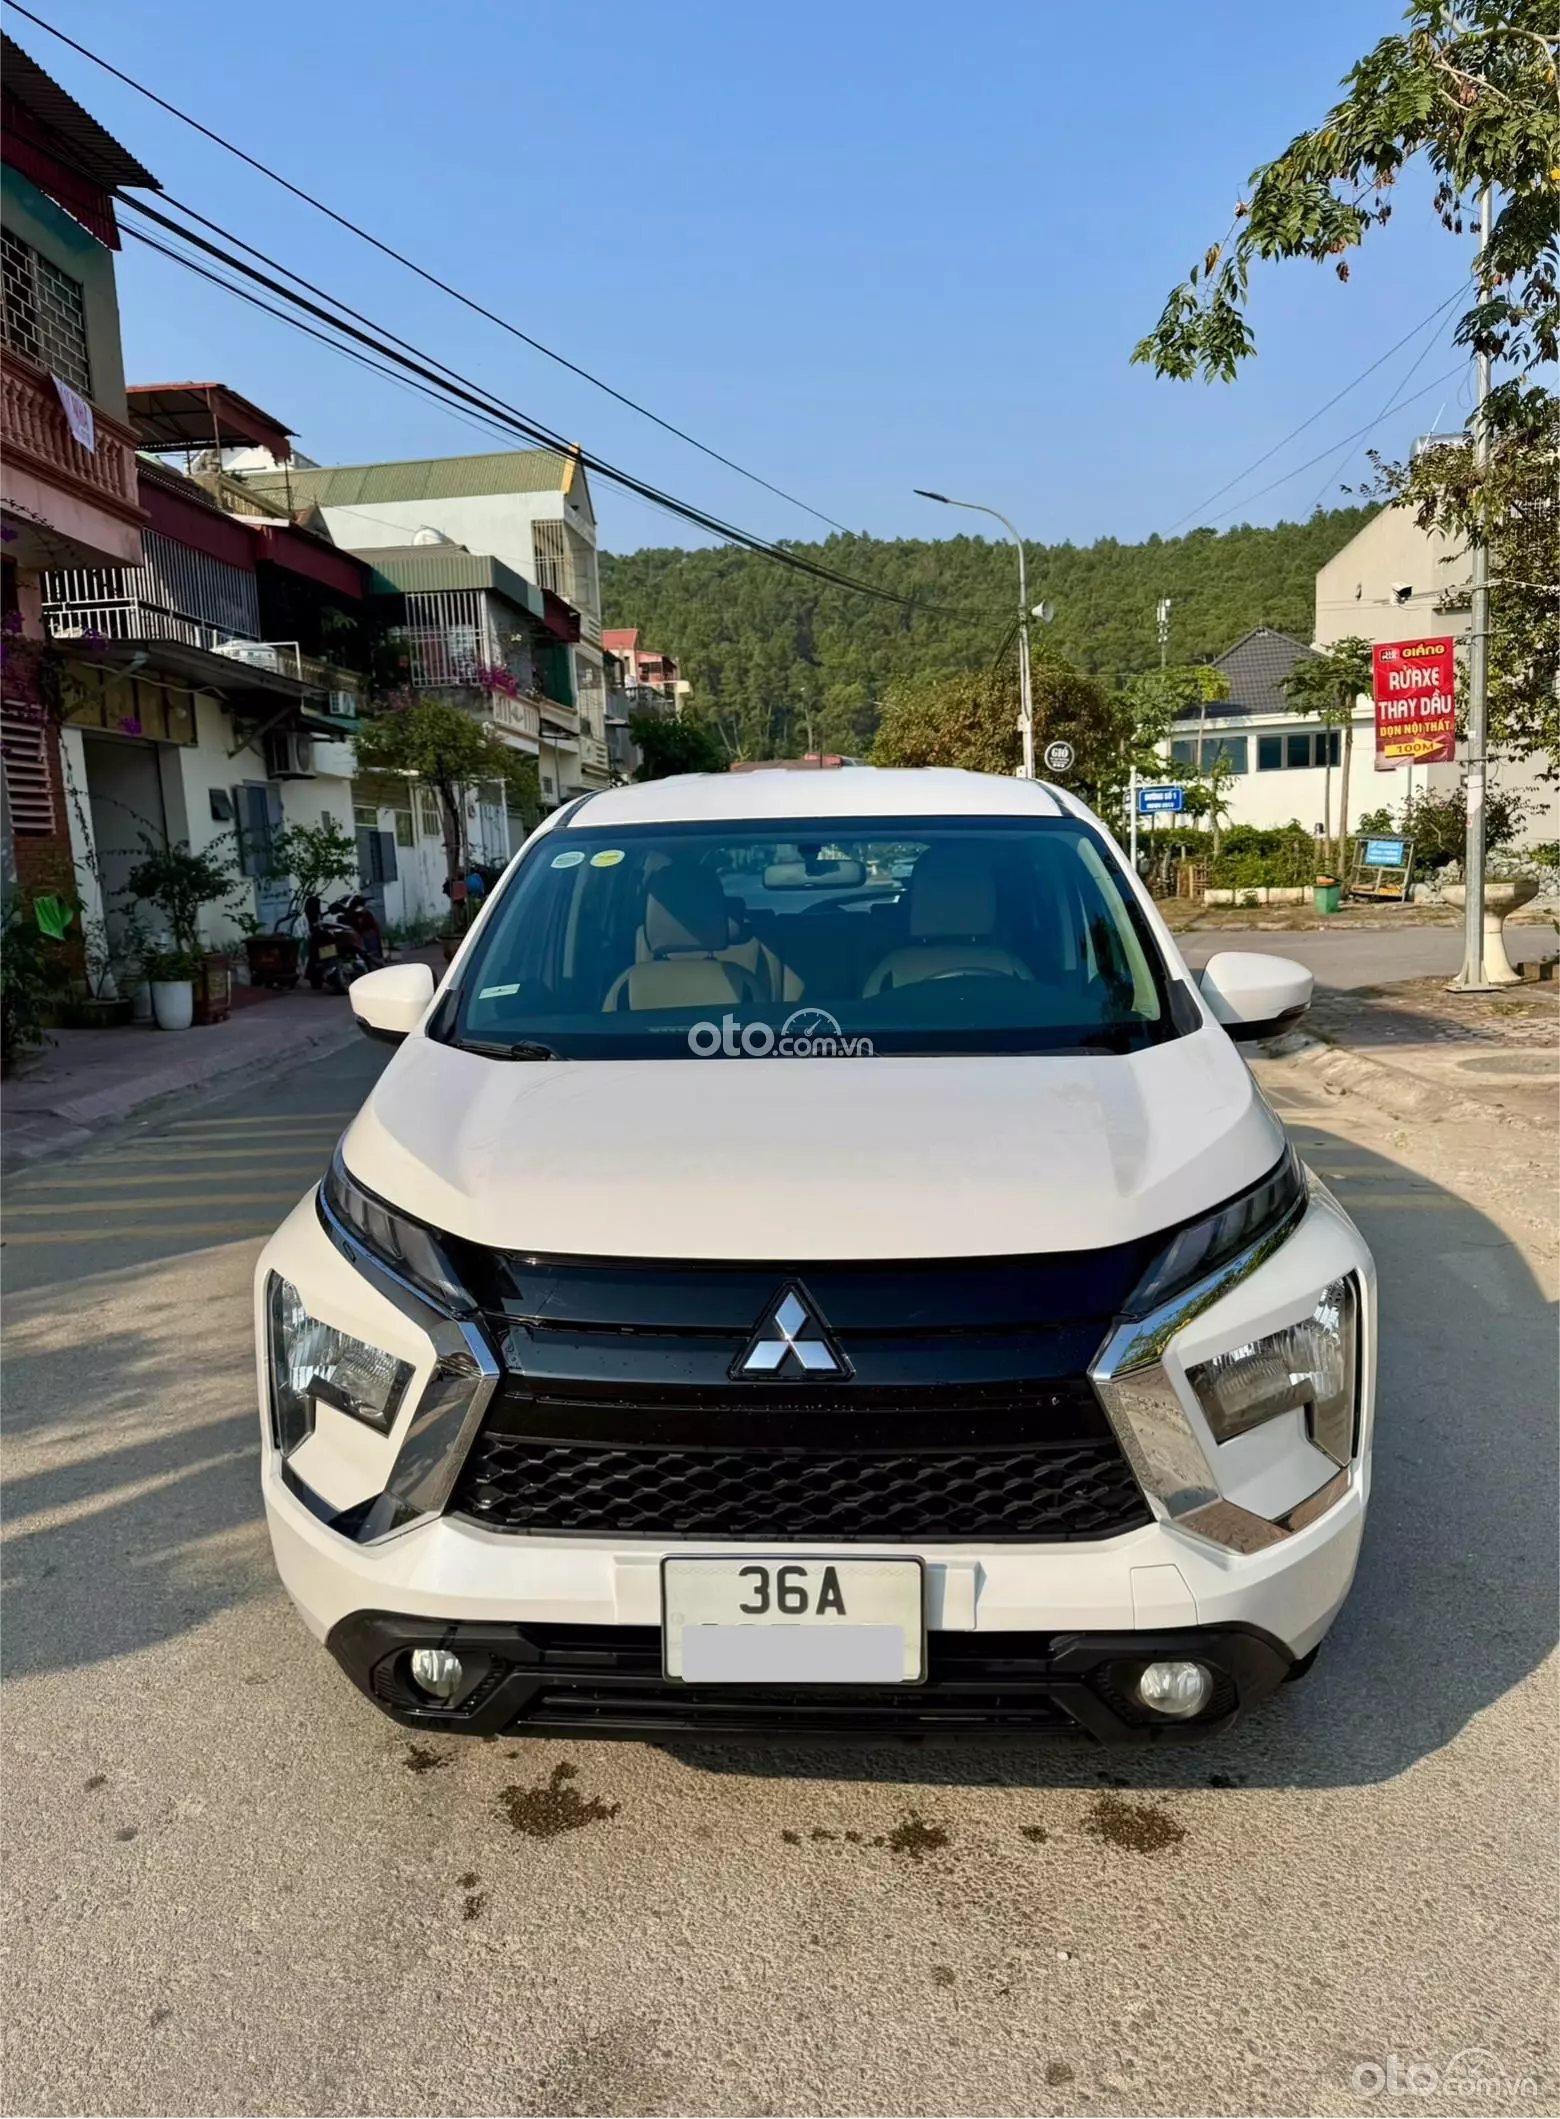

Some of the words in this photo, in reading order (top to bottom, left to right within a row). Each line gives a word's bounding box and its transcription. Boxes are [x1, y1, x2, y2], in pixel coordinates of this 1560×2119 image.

[1378, 697, 1417, 720] THAY
[1420, 689, 1452, 716] DẦU
[1380, 725, 1402, 738] DỌN
[1404, 721, 1423, 735] NỘI
[1424, 718, 1450, 732] THẤT
[1396, 743, 1434, 753] 100M
[739, 1565, 846, 1615] 36A
